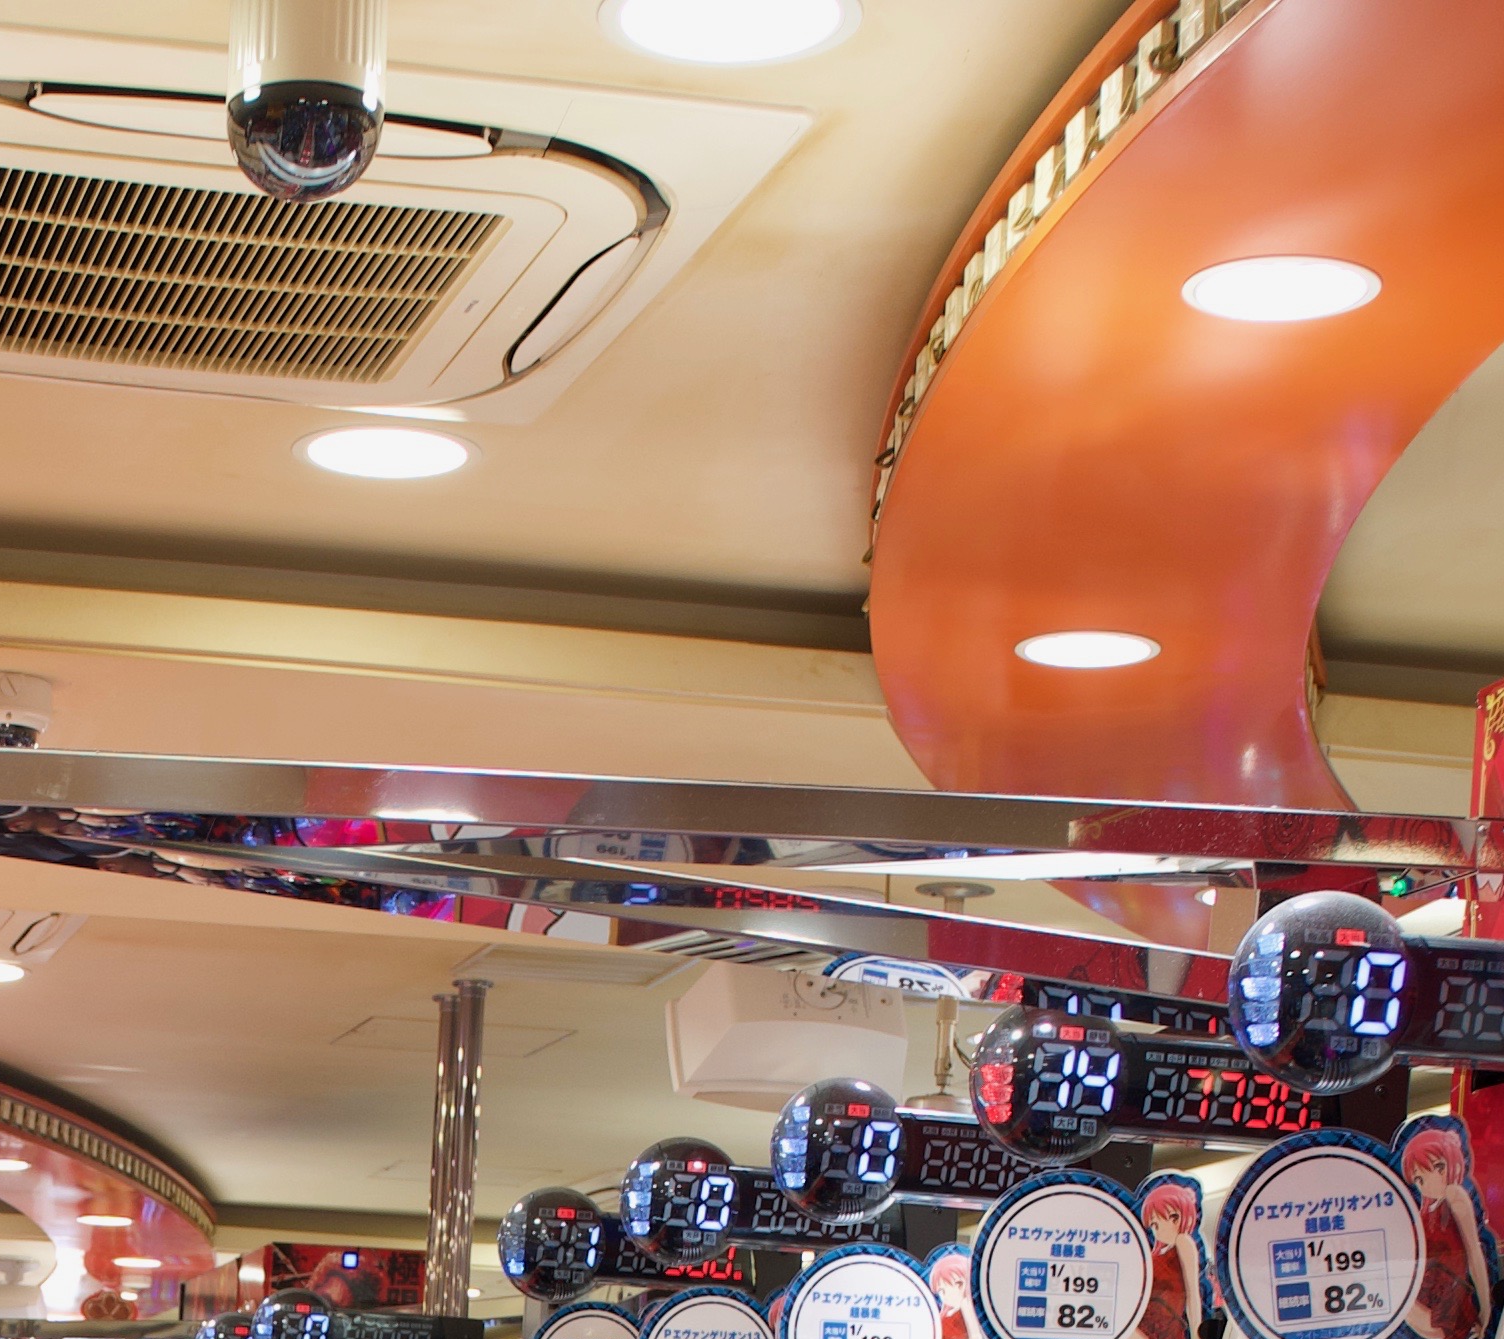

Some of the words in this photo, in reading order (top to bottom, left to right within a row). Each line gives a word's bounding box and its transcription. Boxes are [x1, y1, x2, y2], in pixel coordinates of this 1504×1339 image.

[1349, 951, 1406, 1037] 0
[1058, 1048, 1120, 1114] 14
[1054, 1117, 1076, 1129] 大R
[1080, 1119, 1095, 1136] 箱
[857, 1121, 900, 1183] 0
[695, 1174, 735, 1232] 0
[1254, 1191, 1394, 1221] Pエヴァンゲリオン13
[586, 1226, 600, 1269] 1
[1008, 1227, 1131, 1244] Pエヴァンゲリオン13
[812, 1292, 921, 1308] Pエヴァンゲリオン13
[1324, 1283, 1384, 1314] 82%
[1057, 1304, 1109, 1329] 82%
